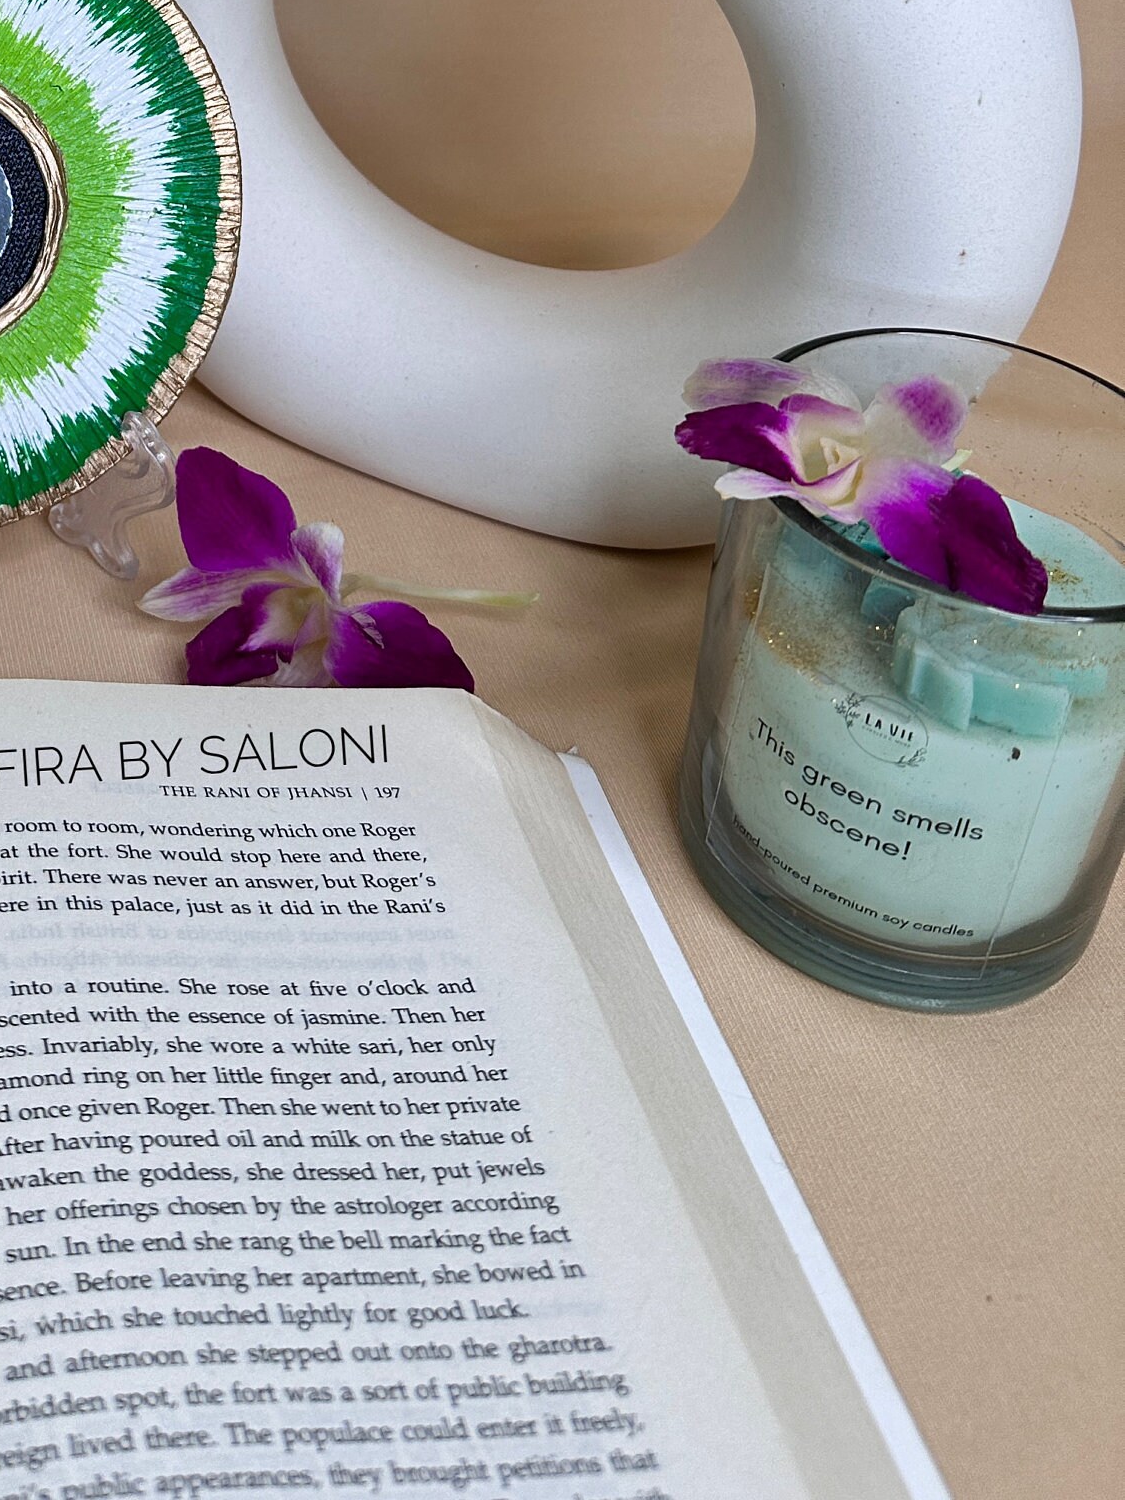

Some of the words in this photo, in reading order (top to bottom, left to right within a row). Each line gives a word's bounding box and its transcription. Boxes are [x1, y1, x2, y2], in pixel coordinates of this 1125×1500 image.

[754, 717, 795, 766] This
[801, 764, 882, 814] green
[892, 807, 984, 841] smells
[159, 785, 197, 797] THE
[202, 787, 251, 798] RANI
[257, 787, 280, 798] OF
[287, 787, 353, 800] JHANSI
[374, 787, 400, 798] 197
[4, 822, 59, 833] room
[62, 820, 82, 832] to
[87, 823, 144, 837] room,
[148, 822, 255, 842] wondering
[258, 823, 318, 838] which
[322, 827, 357, 838] one
[359, 823, 416, 841] Roger
[784, 787, 911, 861] obscene!
[42, 869, 102, 884] There
[107, 874, 147, 885] was
[152, 876, 208, 887] never
[214, 877, 240, 888] an
[245, 878, 319, 891] answer,
[321, 872, 357, 890] but
[733, 815, 811, 886] hand-poured
[812, 881, 878, 918] premium
[882, 913, 910, 929] soy
[912, 920, 974, 937] candles
[36, 896, 58, 910] in
[65, 895, 103, 910] this
[109, 896, 180, 916] palace,
[186, 898, 224, 917] just
[230, 904, 251, 914] as
[258, 900, 274, 915] it
[280, 900, 315, 915] did
[320, 900, 342, 915] in
[347, 900, 379, 914] the
[87, 1006, 142, 1022] with
[145, 1006, 181, 1023] the
[188, 1012, 266, 1024] essence
[273, 1008, 295, 1024] of
[300, 1009, 387, 1030] jasmine.
[390, 1008, 447, 1024] Then
[449, 1006, 486, 1022] her
[89, 1163, 132, 1183] the
[244, 1162, 286, 1181] she
[292, 1162, 379, 1181] dressed
[431, 1162, 473, 1186] put
[475, 1157, 547, 1184] jewels
